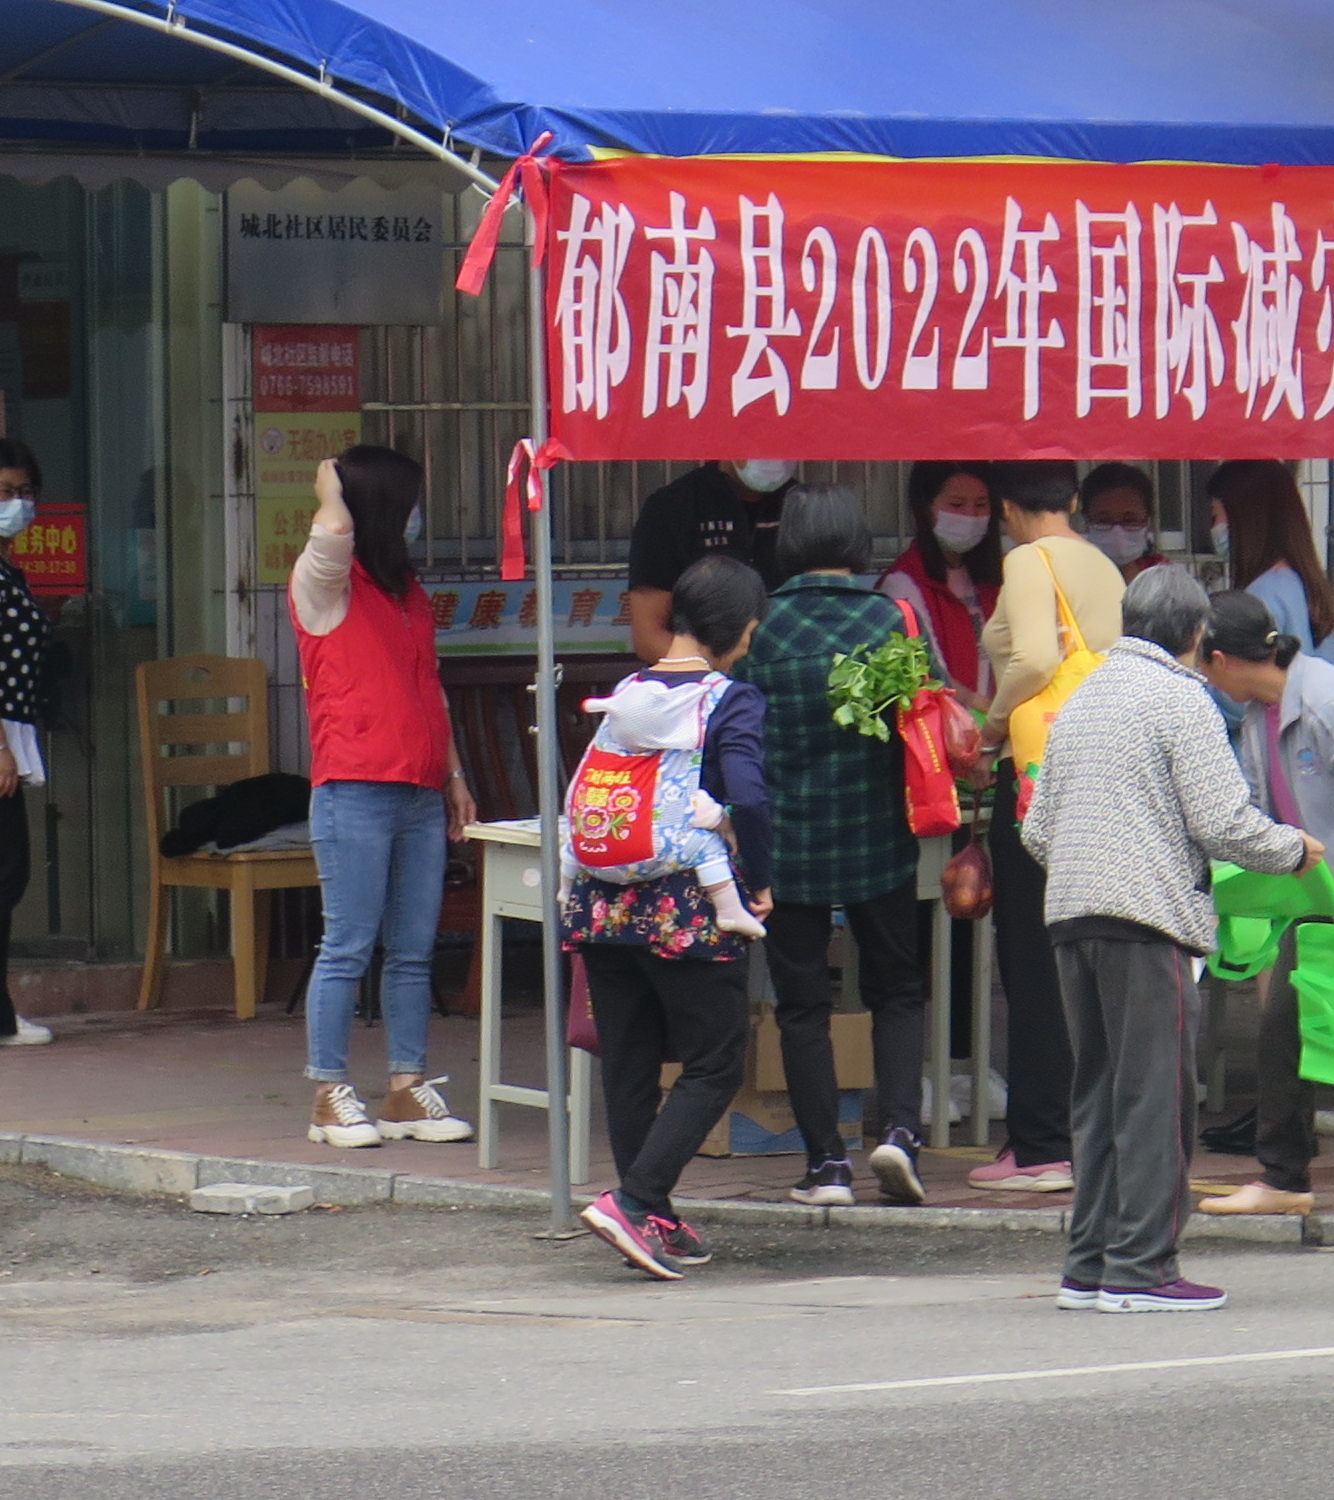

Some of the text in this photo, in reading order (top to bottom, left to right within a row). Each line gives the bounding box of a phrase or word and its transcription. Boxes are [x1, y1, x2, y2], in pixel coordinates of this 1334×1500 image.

[239, 212, 433, 243] 城北社区居民委员会
